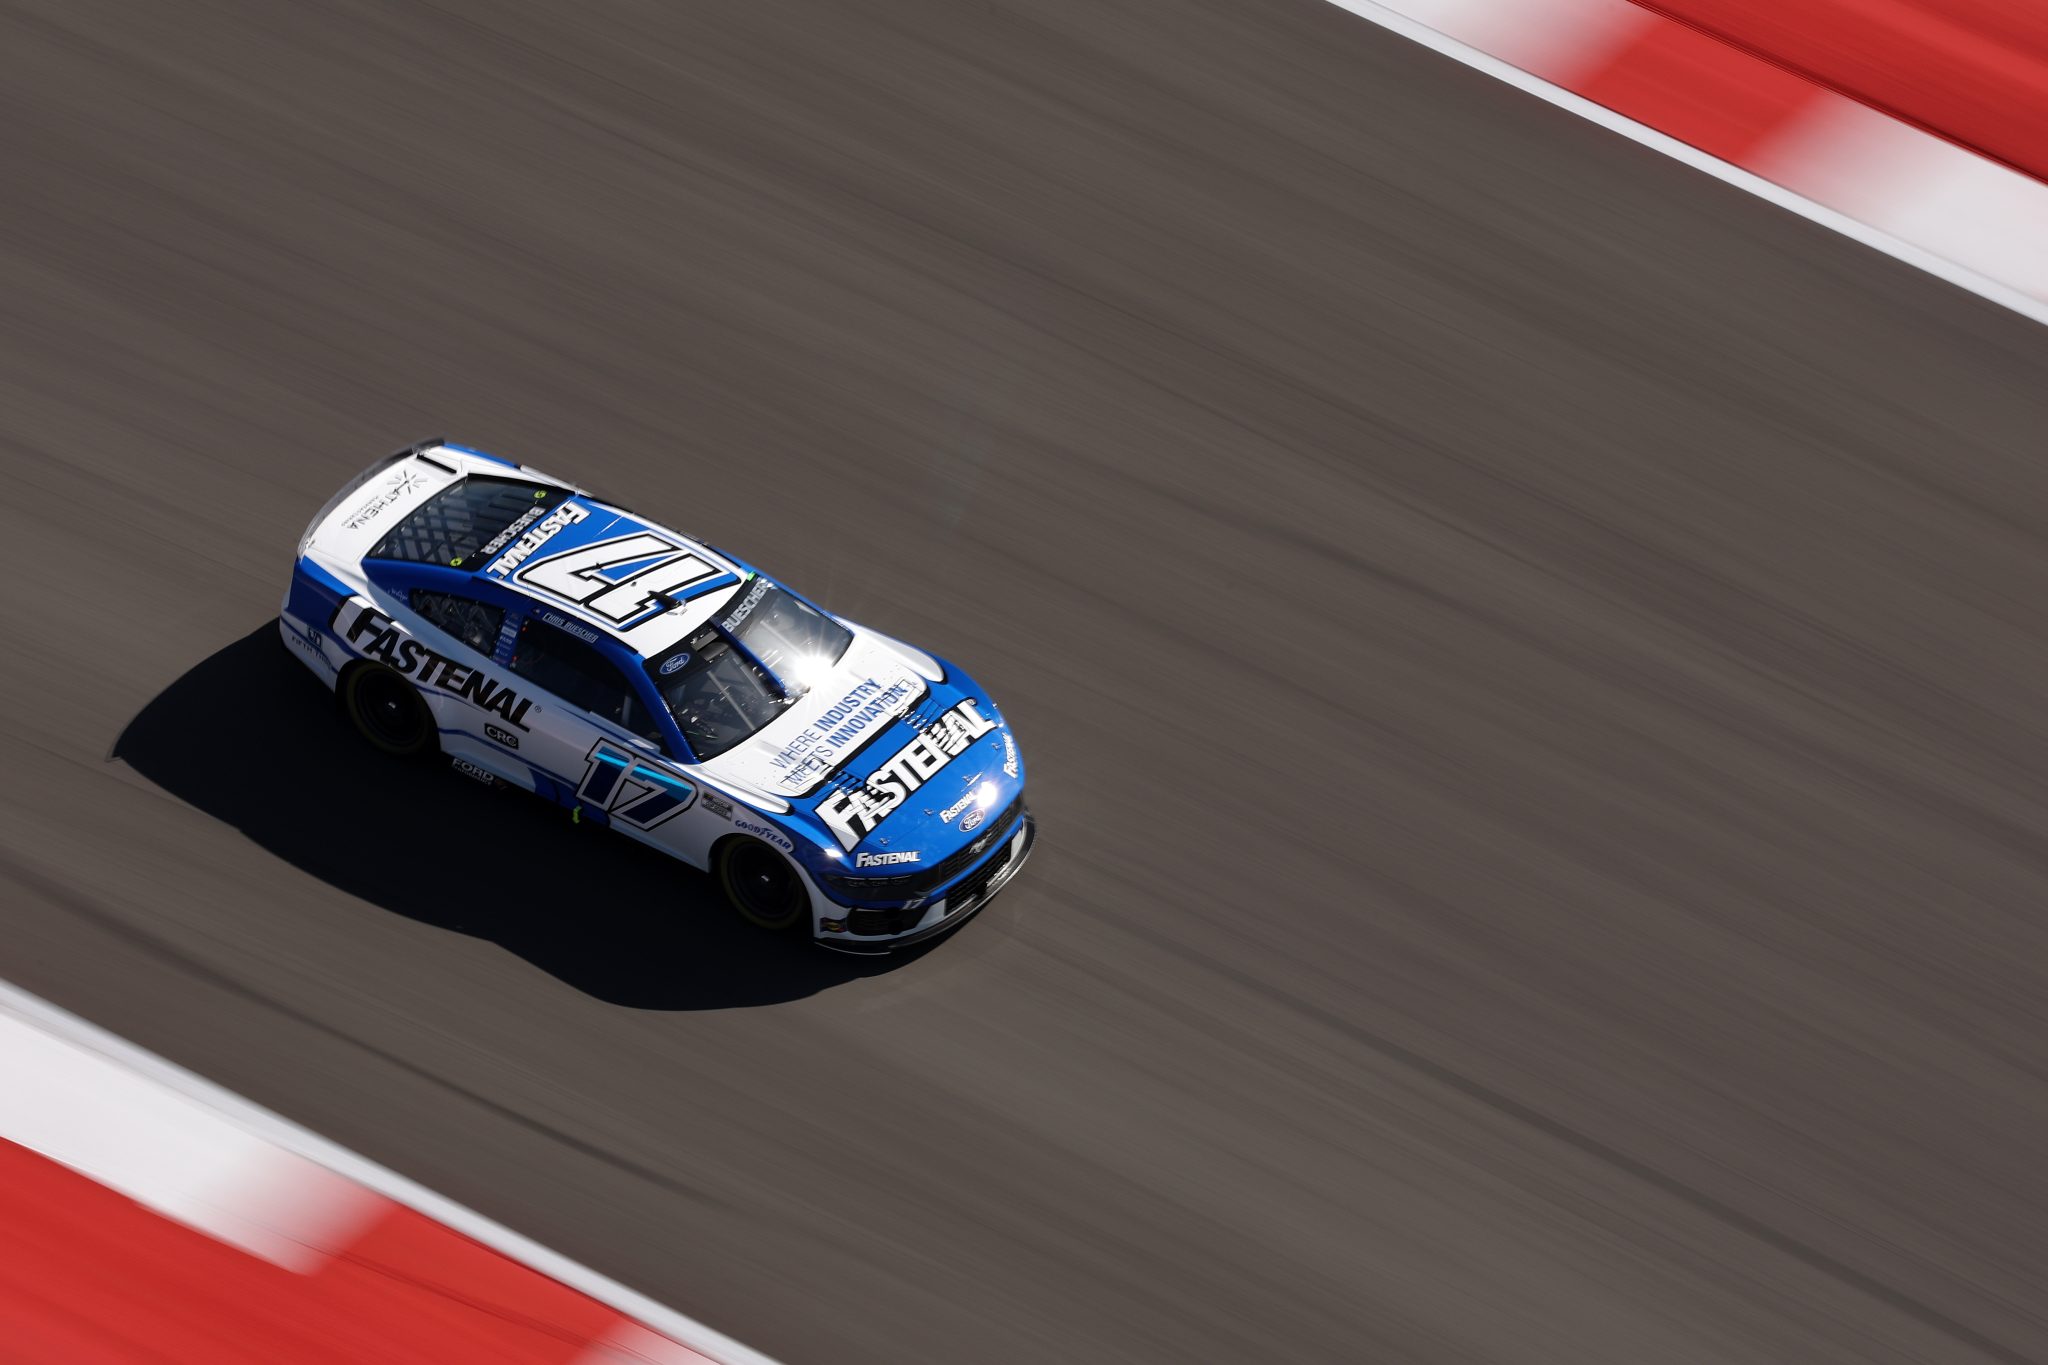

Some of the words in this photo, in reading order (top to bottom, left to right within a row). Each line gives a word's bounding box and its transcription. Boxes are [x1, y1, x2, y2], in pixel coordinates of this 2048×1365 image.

[480, 507, 546, 555] BUESCHER
[486, 501, 591, 579] FASTENAL
[543, 612, 567, 630] CHRIS
[722, 576, 773, 633] BUESCHER
[346, 607, 532, 733] FASTENAL
[663, 655, 689, 674] Ford
[486, 726, 518, 748] CRC
[769, 729, 818, 769] WHERE
[813, 677, 886, 730] INDUSTRY
[783, 743, 833, 787] MEETS
[829, 684, 908, 749] INNOVATION
[576, 738, 699, 832] 17
[815, 697, 998, 853] FASTENAL
[941, 790, 978, 823] FASTENAL
[961, 810, 982, 831] Ford
[735, 819, 792, 850] GOODYEAR
[855, 850, 920, 868] FASTENAL
